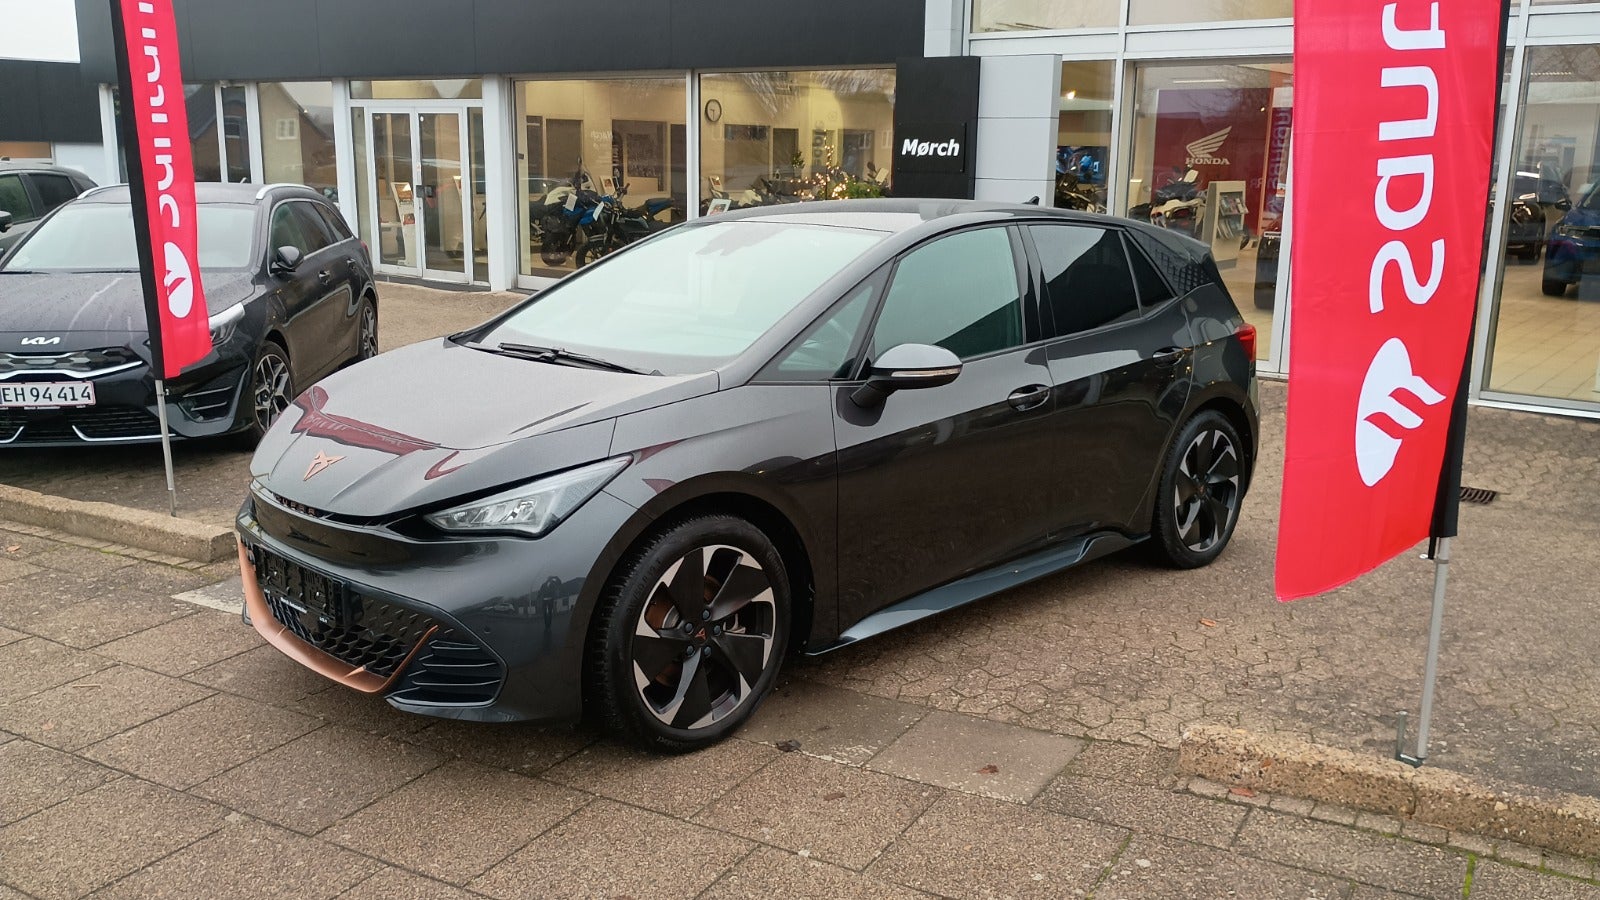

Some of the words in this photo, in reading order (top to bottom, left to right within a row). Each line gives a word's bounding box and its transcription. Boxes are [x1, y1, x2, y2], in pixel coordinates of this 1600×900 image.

[901, 138, 960, 157] Mørch
[1185, 157, 1231, 165] HONDA
[21, 336, 61, 345] KIA
[2, 387, 26, 402] EH
[30, 387, 52, 402] 94
[57, 386, 91, 402] 414
